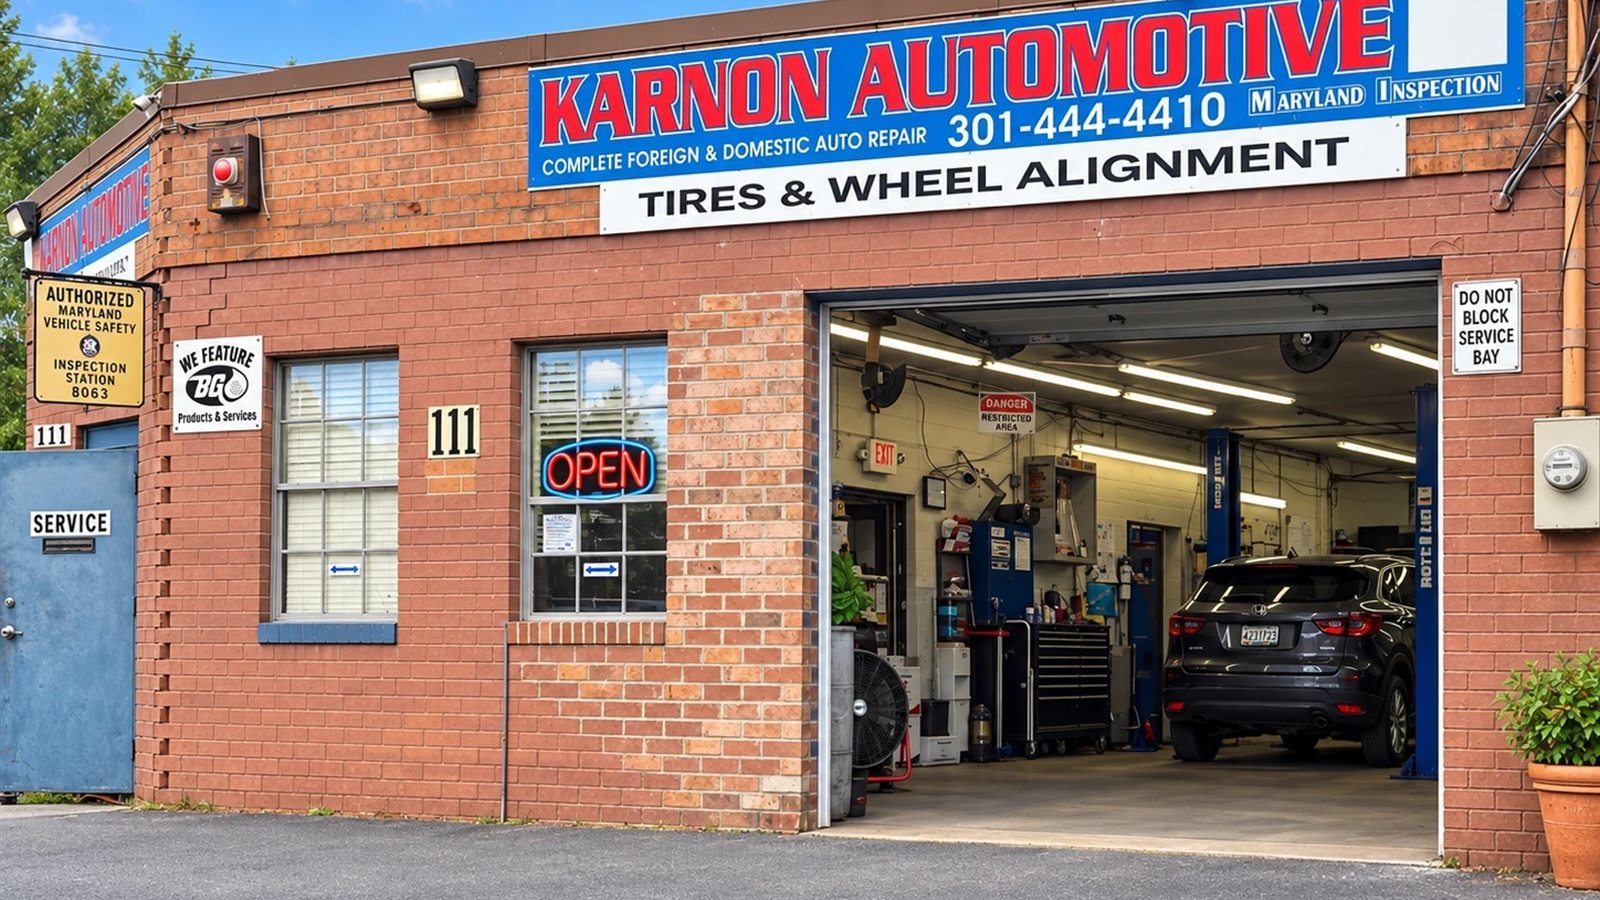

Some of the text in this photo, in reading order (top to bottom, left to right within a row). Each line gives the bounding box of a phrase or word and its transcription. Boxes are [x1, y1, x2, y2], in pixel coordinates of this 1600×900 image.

[540, 0, 1394, 147] KARNON AUTOMOTIVE
[1251, 73, 1500, 113] MARYLAND INSPECTION
[947, 92, 1226, 148] 301-444-4410
[542, 127, 927, 176] COMPLETE FOREIGN & DOMESTIC AUTO REPAIR
[638, 137, 1350, 218] TIRES & WHEEL ALIGNMENT
[46, 286, 134, 308] AUTHORIZED
[1459, 287, 1513, 306] DO NOT
[58, 305, 122, 320] MARYLAND
[1463, 308, 1509, 326] BLOCK
[44, 316, 136, 334] VEHICLE SAFETY
[1459, 328, 1514, 346] SERVICE
[54, 359, 127, 373] INSPECTION
[179, 345, 255, 373] WE FEATURE
[1473, 348, 1500, 365] BAY
[66, 372, 115, 386] STATION
[194, 373, 227, 399] BG
[72, 387, 108, 399] 8063
[986, 398, 1028, 409] DANGER
[178, 410, 257, 424] Products & Services
[981, 413, 1032, 423] RESTRICTED
[38, 425, 66, 446] 111
[432, 407, 476, 456] 111
[995, 423, 1018, 431] AREA
[875, 442, 894, 466] EXIT
[547, 451, 647, 490] OPEN
[34, 513, 107, 533] SERVICE
